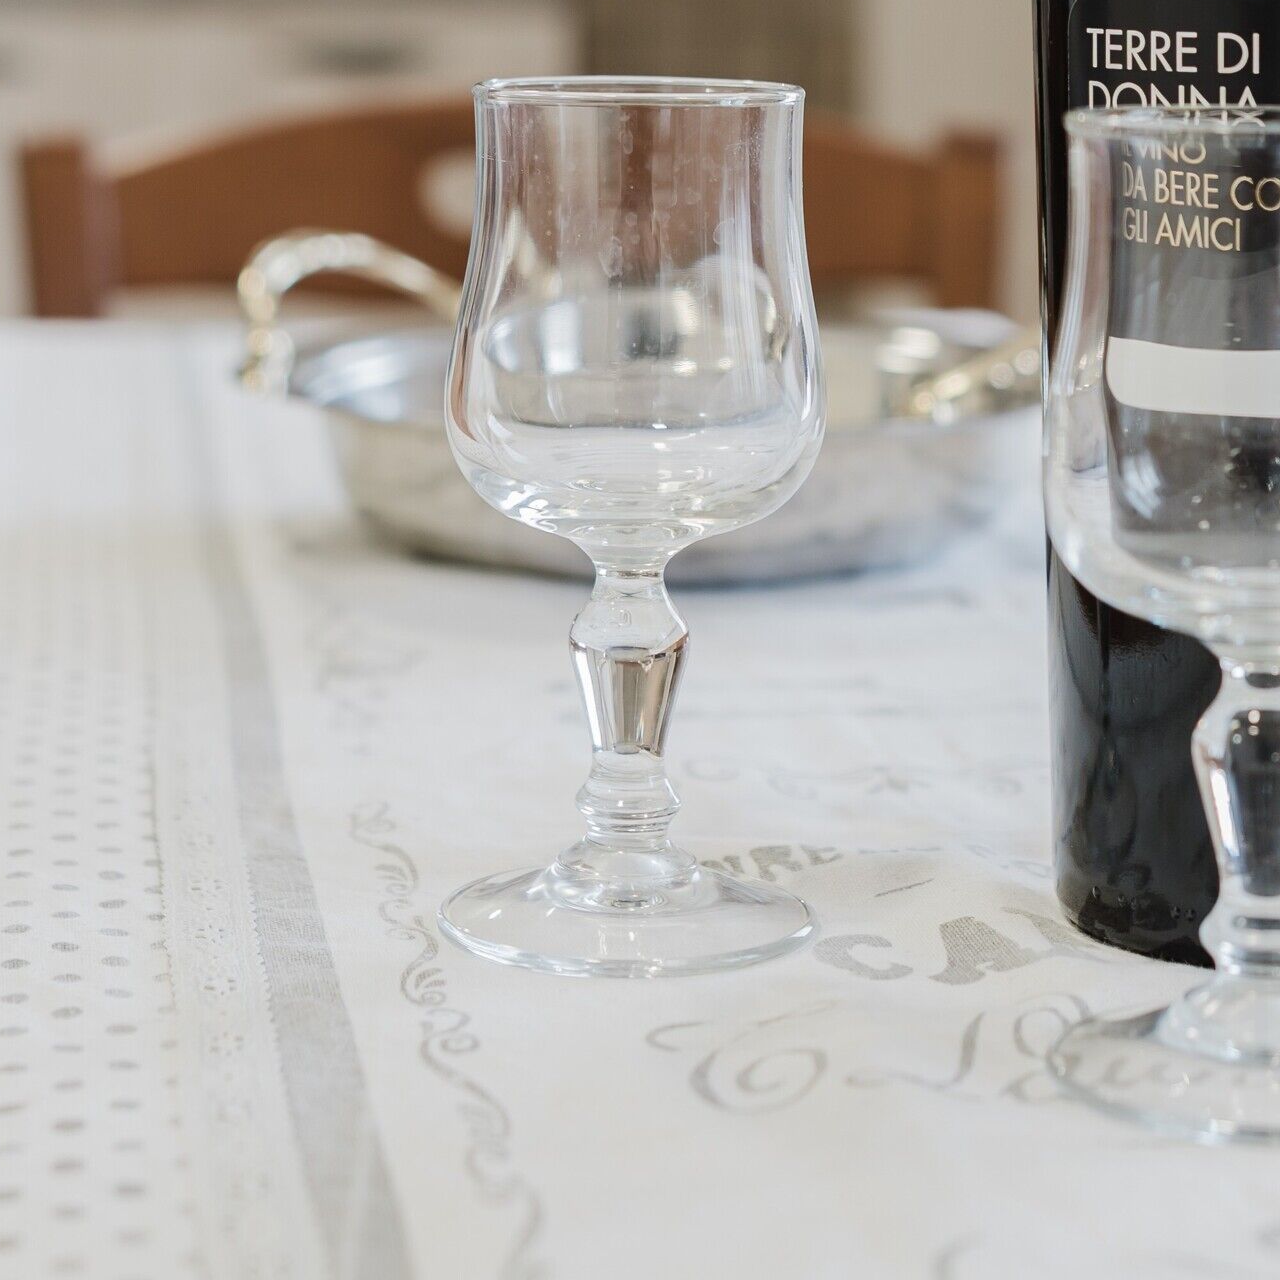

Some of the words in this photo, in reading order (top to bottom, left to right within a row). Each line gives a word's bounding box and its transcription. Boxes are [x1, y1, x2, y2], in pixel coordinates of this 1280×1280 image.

[1087, 28, 1198, 73] TERRE
[1217, 32, 1260, 75] DI
[1122, 161, 1148, 201] DA
[1154, 168, 1219, 209] BERE
[1122, 207, 1148, 244] GLI
[1154, 211, 1242, 252] AMICI
